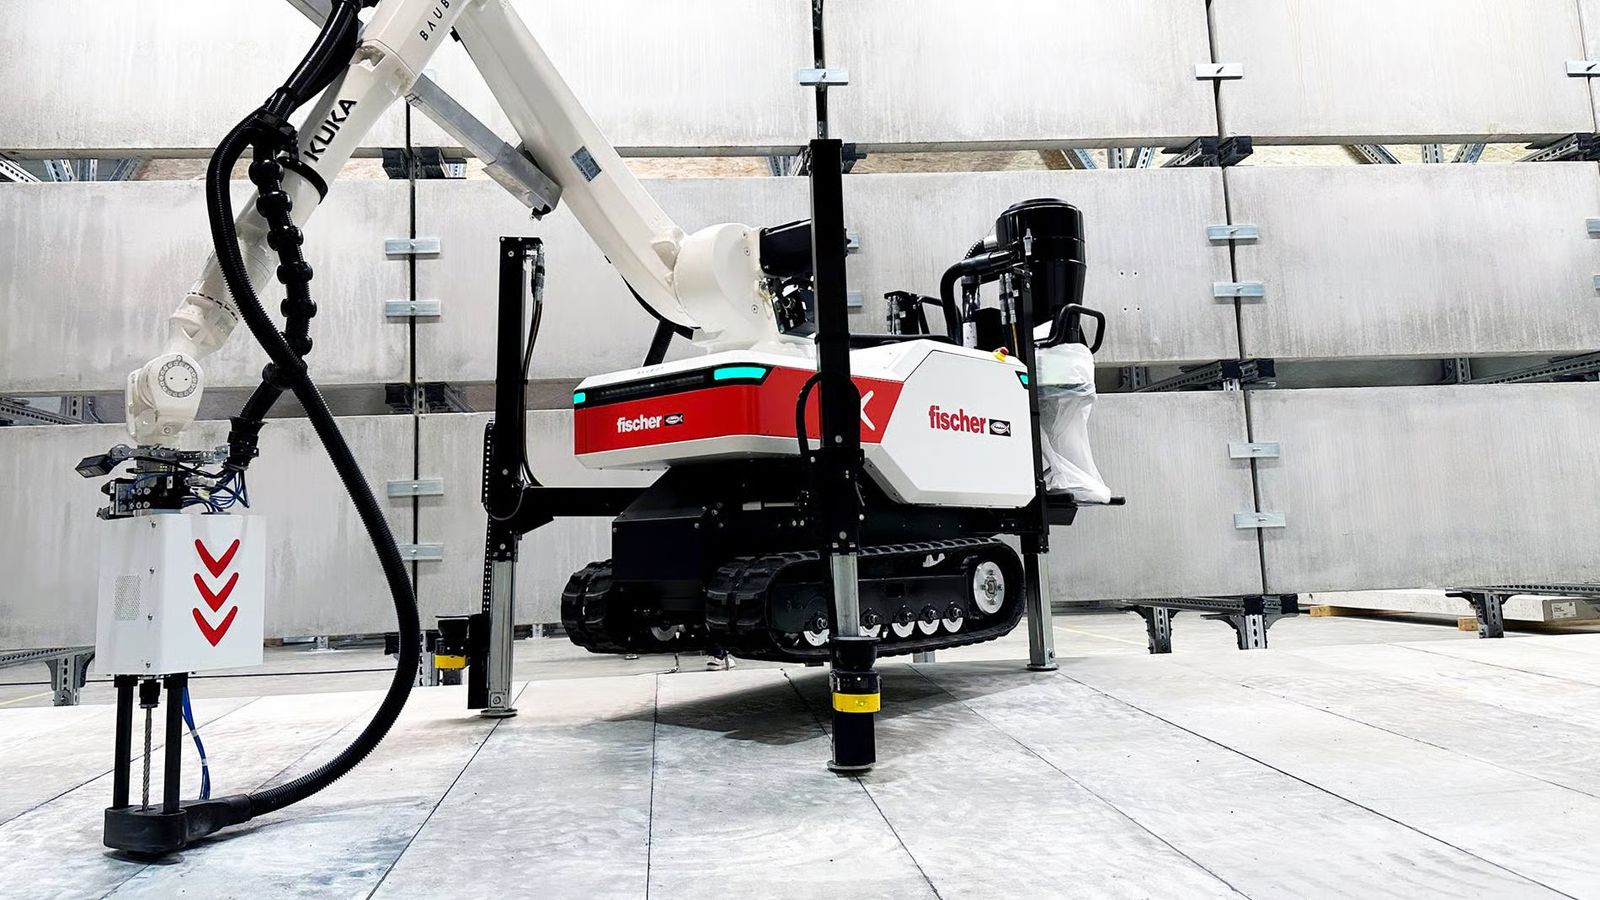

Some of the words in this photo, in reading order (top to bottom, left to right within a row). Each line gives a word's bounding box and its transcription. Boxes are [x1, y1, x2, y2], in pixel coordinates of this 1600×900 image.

[303, 99, 358, 162] KUKA
[616, 413, 662, 433] fischer
[928, 404, 986, 434] fischer
